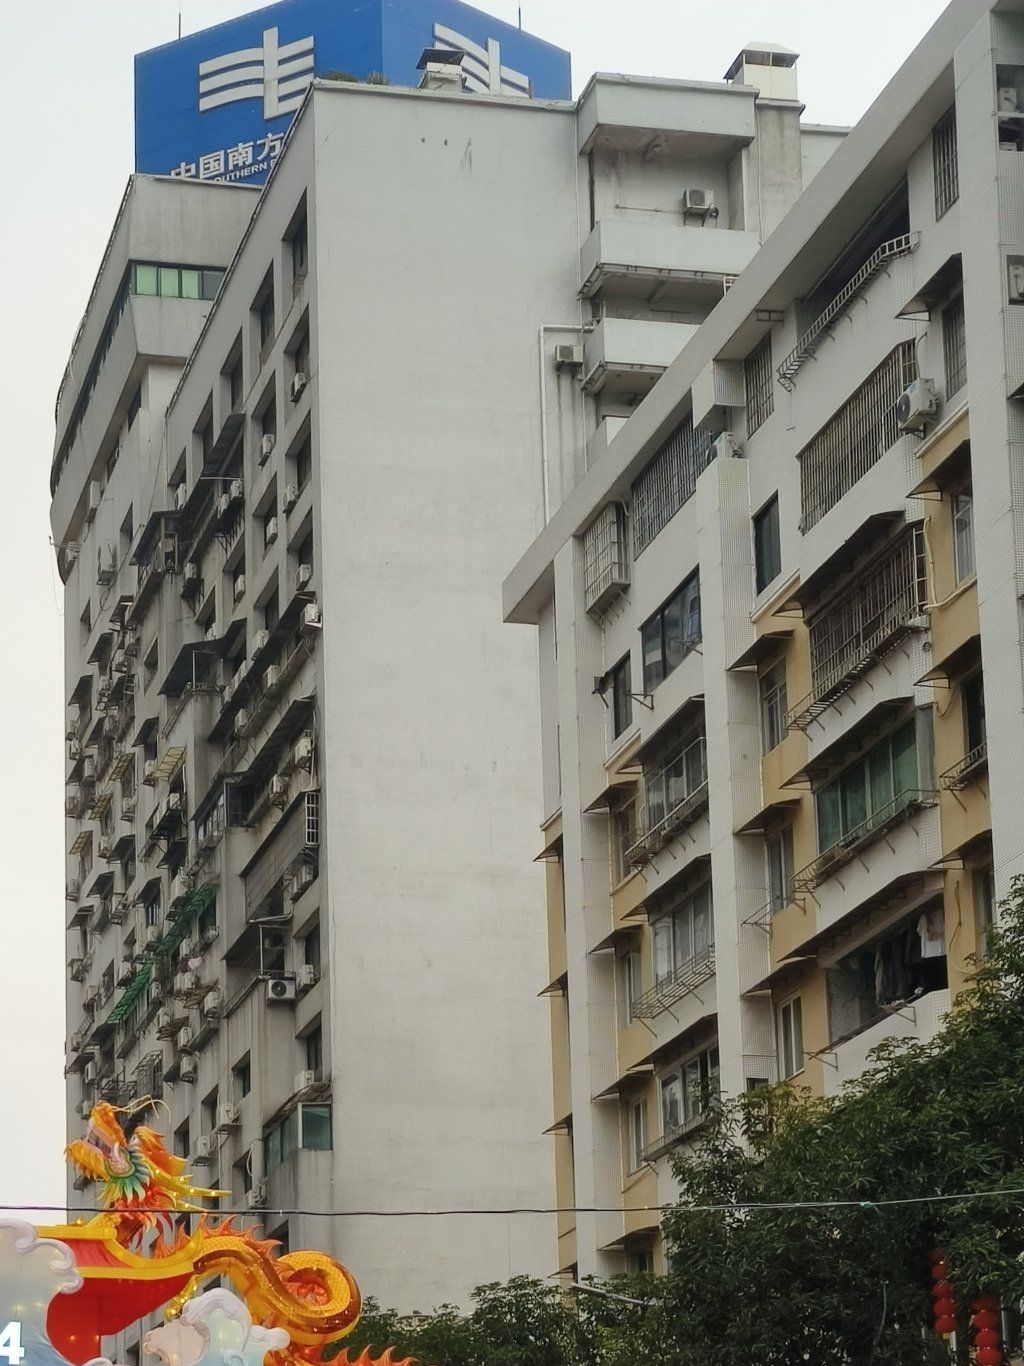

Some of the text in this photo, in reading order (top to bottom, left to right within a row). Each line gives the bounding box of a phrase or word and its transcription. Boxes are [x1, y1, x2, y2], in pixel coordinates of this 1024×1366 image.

[171, 132, 284, 181] 中国南方
[210, 161, 267, 184] OUTHERN
